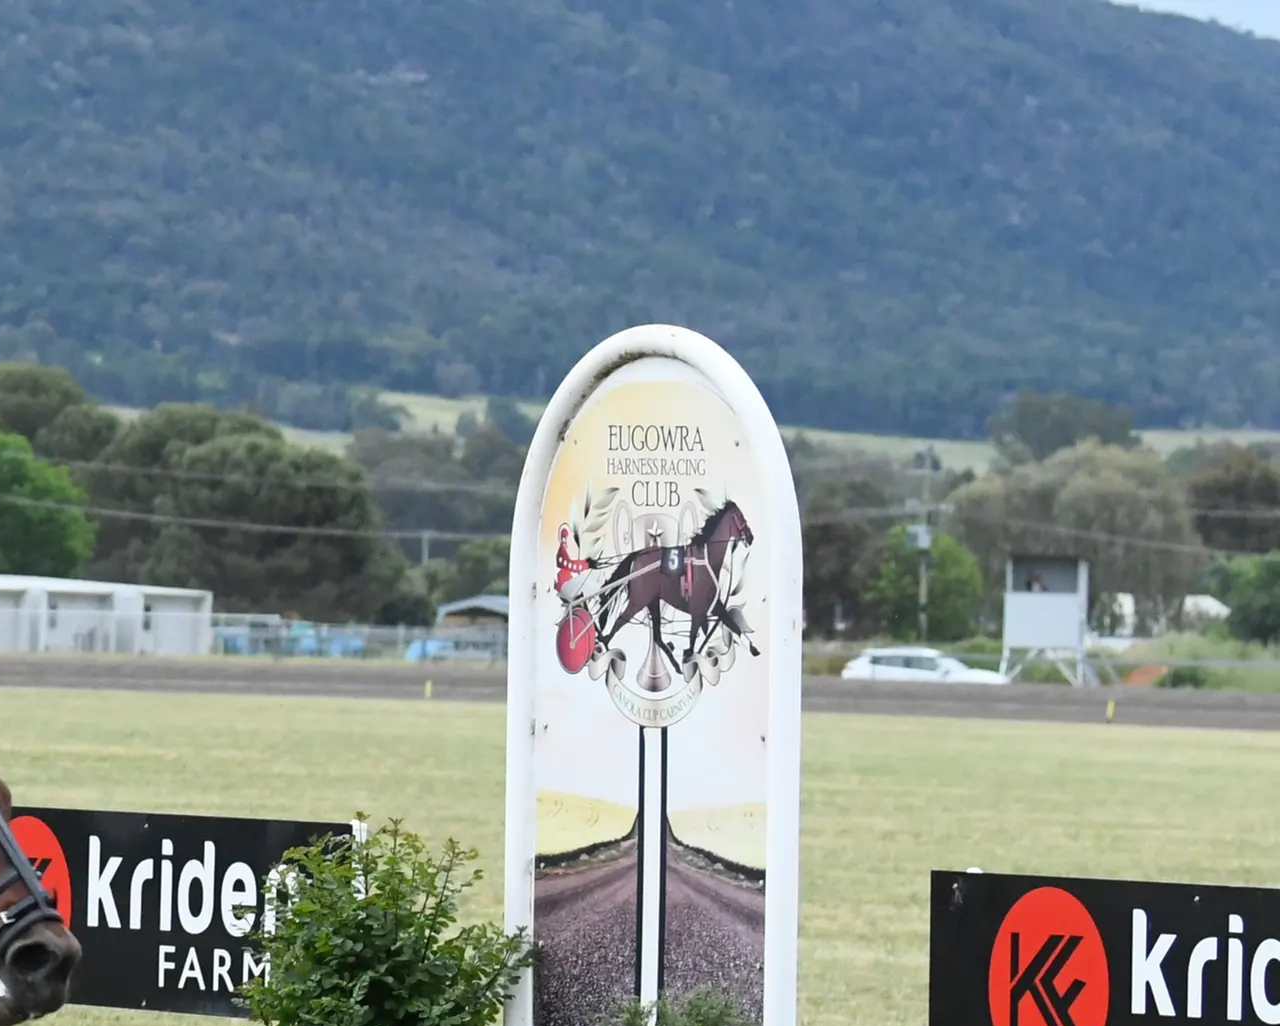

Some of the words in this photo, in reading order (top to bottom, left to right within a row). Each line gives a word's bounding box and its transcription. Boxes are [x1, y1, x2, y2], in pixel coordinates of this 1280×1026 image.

[608, 425, 705, 452] EUGOWRA
[607, 457, 659, 475] HARNESS
[661, 458, 706, 476] RACING
[632, 481, 681, 508] CLUB
[668, 551, 680, 571] 5
